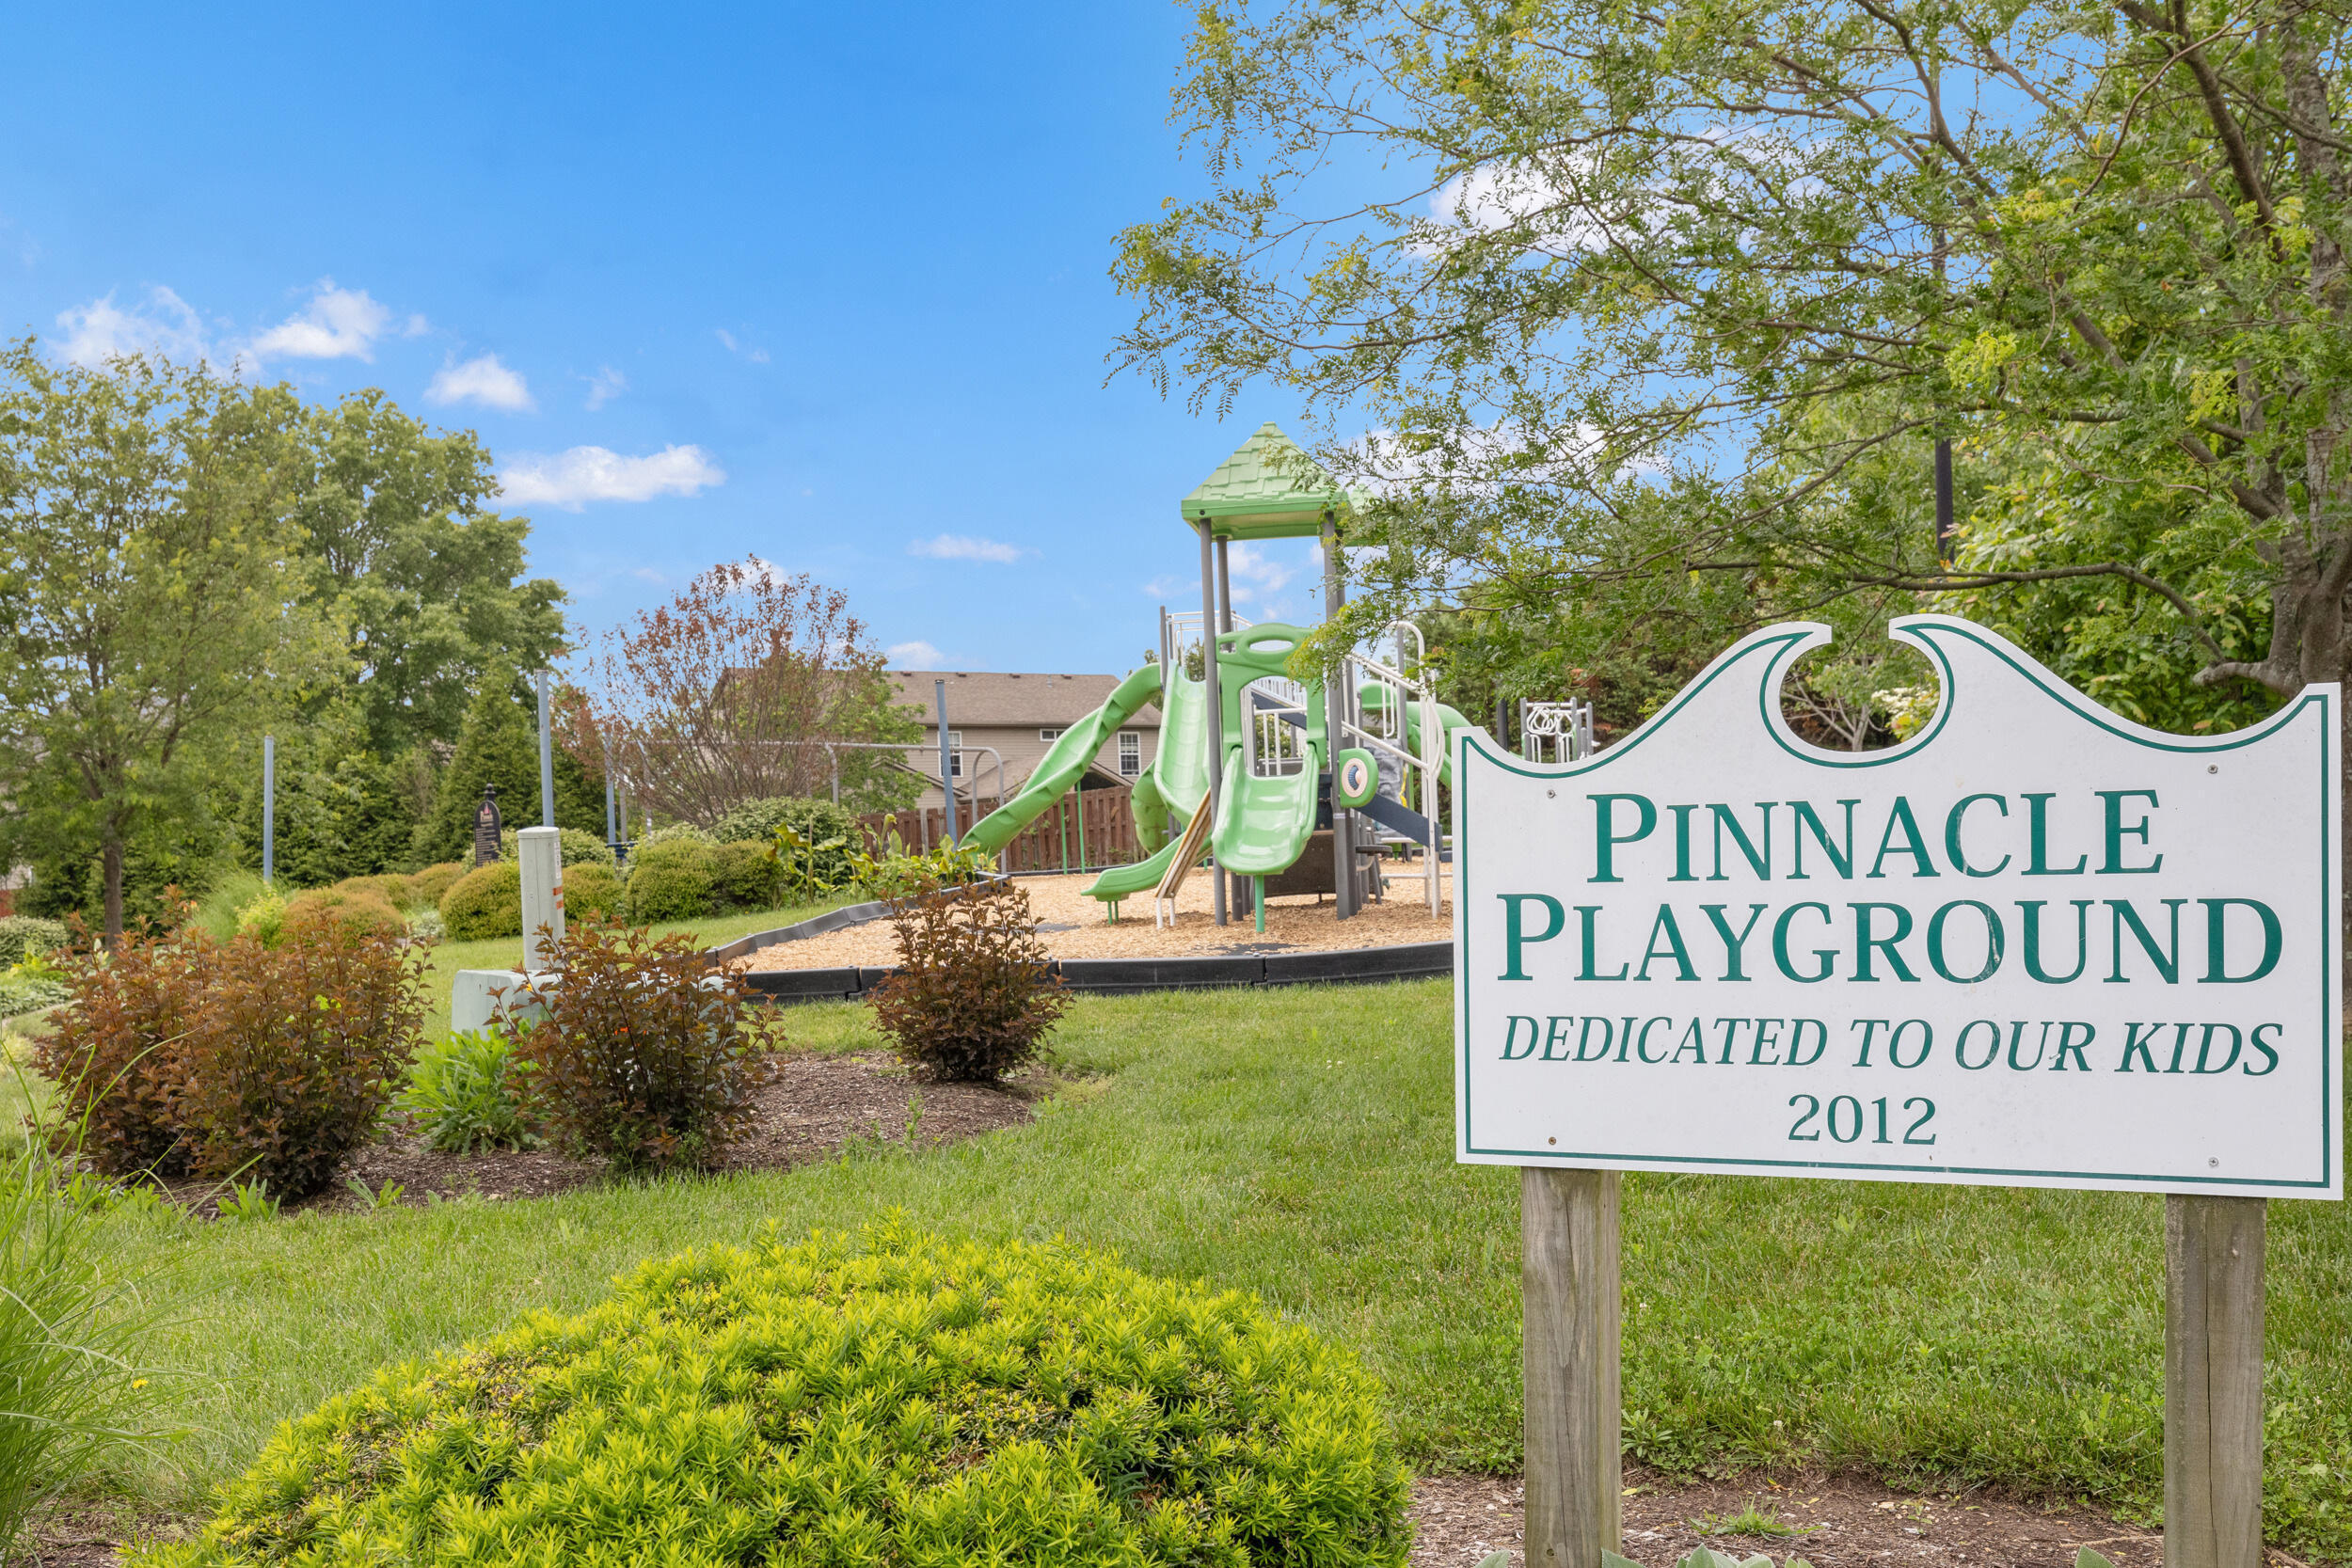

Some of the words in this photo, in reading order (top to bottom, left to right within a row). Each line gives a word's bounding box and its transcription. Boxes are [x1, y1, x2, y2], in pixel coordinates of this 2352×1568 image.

[1585, 788, 2165, 883] PINNACLE
[1496, 893, 2284, 985] PLAYGROUND
[1498, 1015, 1829, 1066] DEDICATED
[1850, 1019, 1934, 1069] TO
[1955, 1020, 2096, 1072] OUR
[2114, 1022, 2284, 1076] KIDS
[1788, 1094, 1937, 1146] 2012
